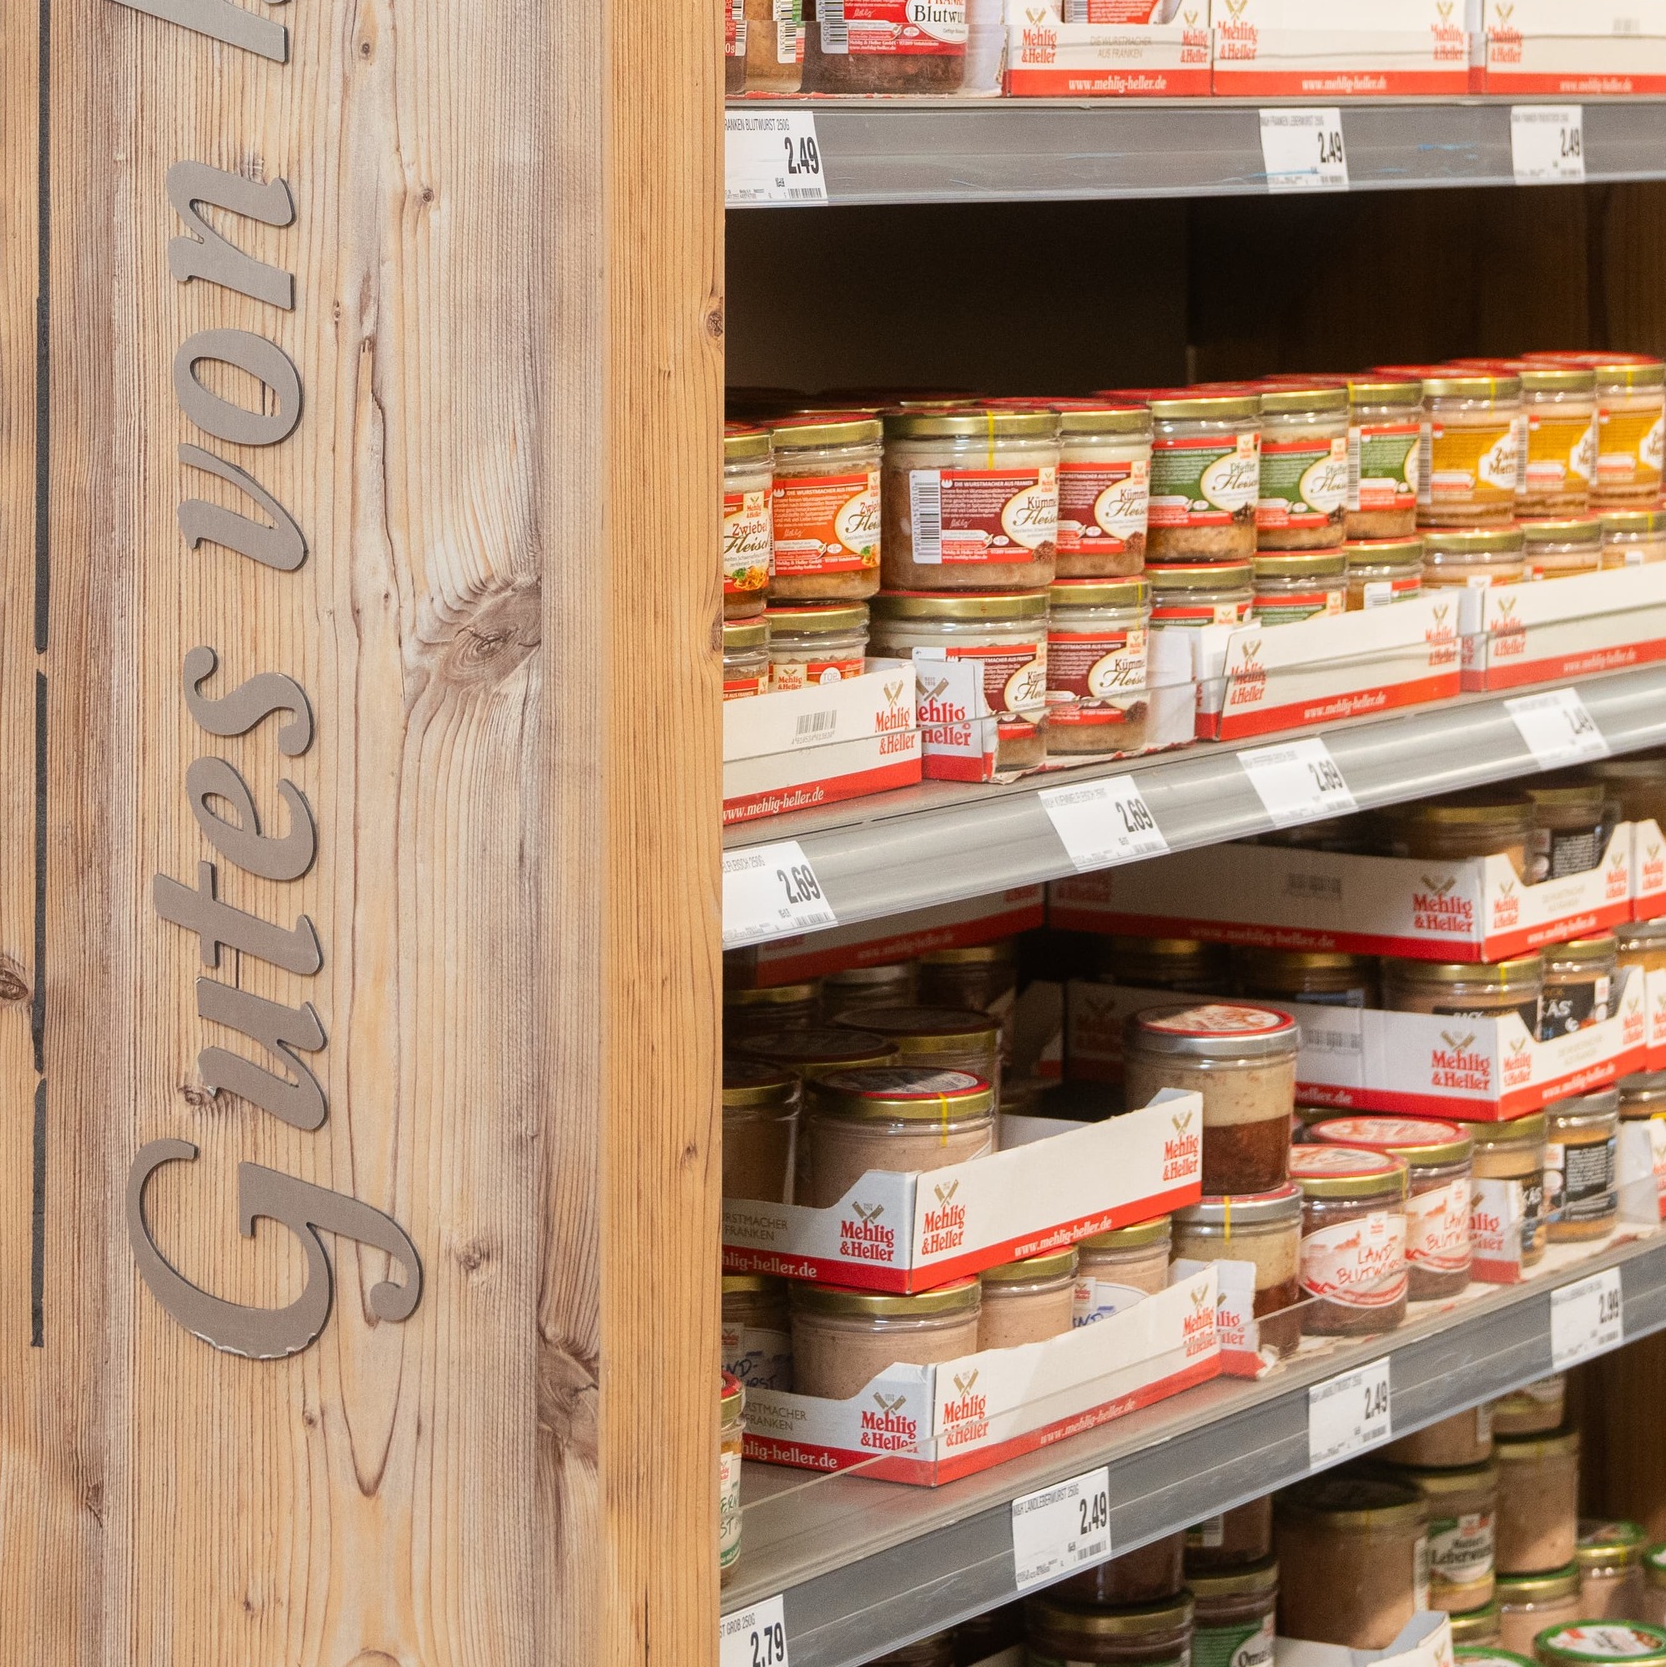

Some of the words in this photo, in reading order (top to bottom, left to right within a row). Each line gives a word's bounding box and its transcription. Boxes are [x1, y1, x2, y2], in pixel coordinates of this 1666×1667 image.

[1022, 29, 1057, 49] Mehlig
[1182, 31, 1208, 48] Mehlig
[1021, 49, 1056, 64] &Heller
[1098, 49, 1111, 59] AUS
[1112, 49, 1142, 59] FRANKEN
[1069, 75, 1166, 93] www.mehlig-heller.de
[1301, 76, 1387, 92] www.mehlig-heller.de
[746, 119, 775, 130] BLUTWURST
[777, 119, 789, 130] 250G
[784, 137, 819, 174] 2.49
[1318, 132, 1343, 164] 2.49
[167, 158, 308, 572] von
[778, 675, 802, 686] Mehlig
[875, 706, 911, 733] Mehlig
[879, 733, 915, 755] &Heller
[1115, 798, 1154, 832] 2.69
[777, 864, 820, 904] 2.69
[1413, 894, 1473, 918] Mehlig
[1414, 914, 1473, 933] &Heller
[133, 645, 424, 1360] Gutes
[1431, 1050, 1491, 1075] Mehlig
[1431, 1072, 1490, 1091] &Heller
[1164, 1135, 1199, 1161] Mehlig
[1162, 1159, 1198, 1181] &Heller
[923, 1203, 966, 1231] Mehlig
[840, 1219, 895, 1243] Mehlig
[1014, 1215, 1113, 1258] www.mehlig-heller.de
[840, 1242, 894, 1263] &Heller
[921, 1233, 963, 1255] &Heller
[943, 1393, 987, 1422] Mehlig
[1364, 1380, 1388, 1421] 2.49
[861, 1410, 917, 1435] Mehlig
[861, 1433, 919, 1454] &Heller
[1024, 1490, 1068, 1514] LANDLEBERWURST
[1068, 1487, 1080, 1498] 250G
[1079, 1491, 1108, 1535] 2.49
[726, 1616, 742, 1634] GROB
[742, 1612, 756, 1629] 250G
[750, 1621, 784, 1667] 2.79
